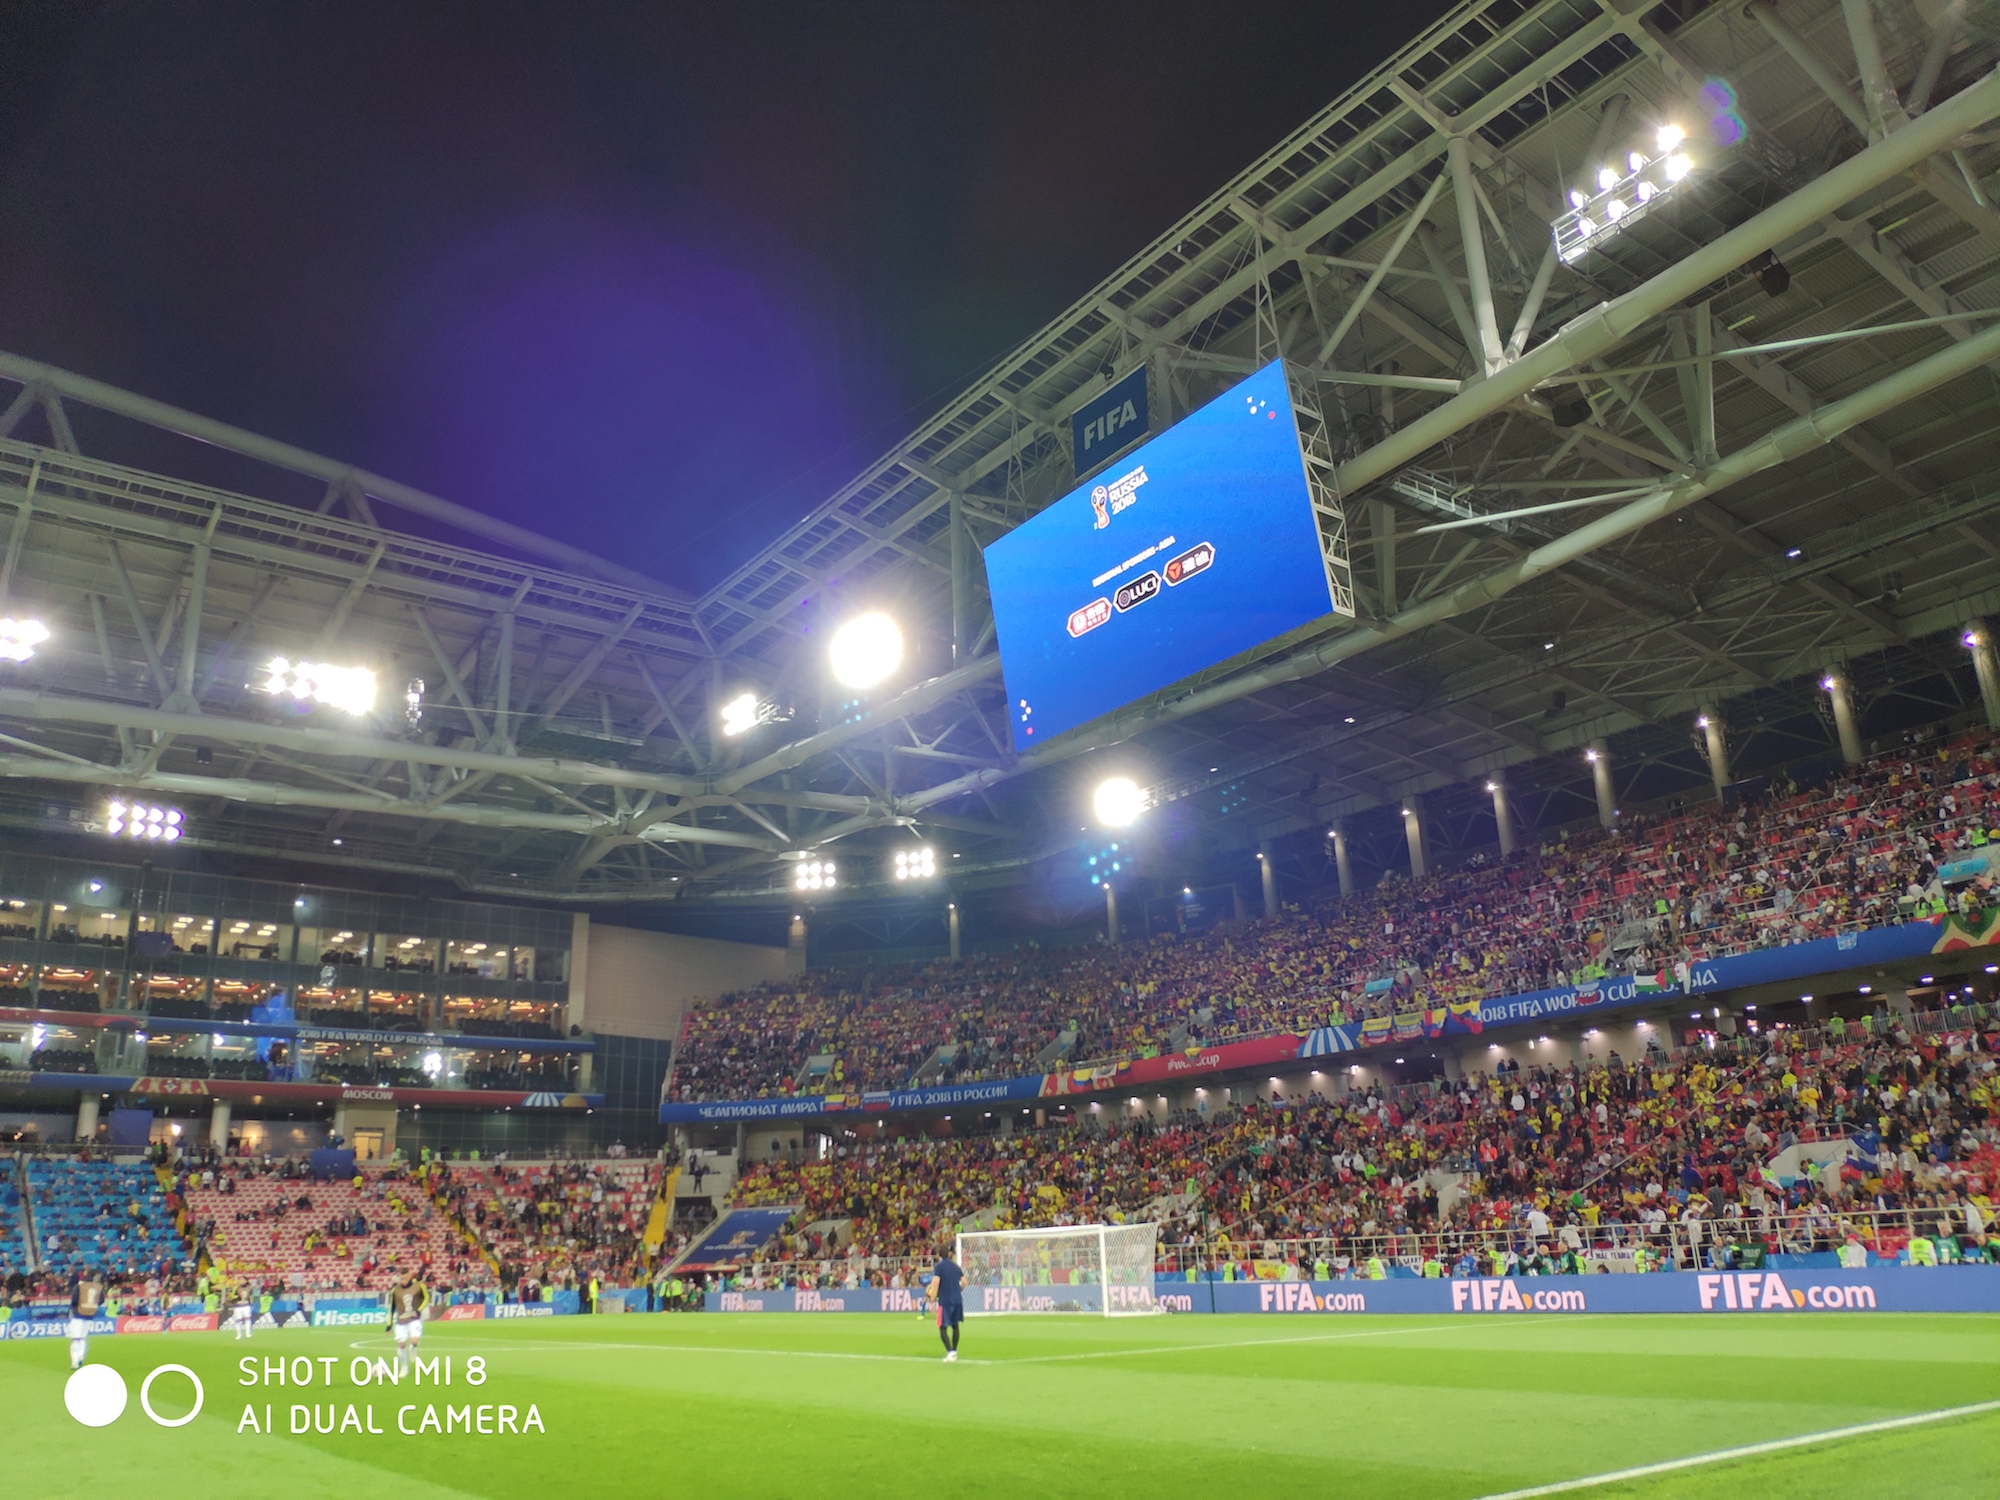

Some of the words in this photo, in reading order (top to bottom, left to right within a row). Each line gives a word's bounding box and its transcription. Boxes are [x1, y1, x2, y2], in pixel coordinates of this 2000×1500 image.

[1084, 399, 1137, 451] FIFA
[1109, 472, 1148, 503] RUSSIA
[1112, 492, 1137, 515] 2018
[1129, 577, 1157, 600] LUCI
[1509, 1000, 1543, 1018] FIFA
[1544, 988, 1605, 1012] WOD
[296, 1029, 320, 1038] 2018
[321, 1030, 345, 1040] FIFA
[345, 1032, 383, 1042] WORLD
[383, 1034, 405, 1043] CUP
[406, 1035, 445, 1045] RUSSIA
[342, 1089, 394, 1100] MOSCOW
[699, 1103, 778, 1118] ЧЕМПИОНАТ
[780, 1101, 818, 1114] МИРА
[898, 1094, 923, 1107] FIFA
[925, 1092, 951, 1105] 2018
[953, 1090, 962, 1100] В
[963, 1085, 1008, 1101] РОССИИ
[720, 1293, 763, 1311] FIFA.com
[795, 1291, 844, 1311] FIFA.com
[881, 1289, 939, 1311] FIFA.c
[1260, 1283, 1366, 1311] FIFA.com
[1452, 1279, 1586, 1311] FIFA.com
[1697, 1273, 1877, 1310] FIFA.com
[494, 1304, 553, 1318] FIFA.com
[31, 1323, 62, 1336] 万达
